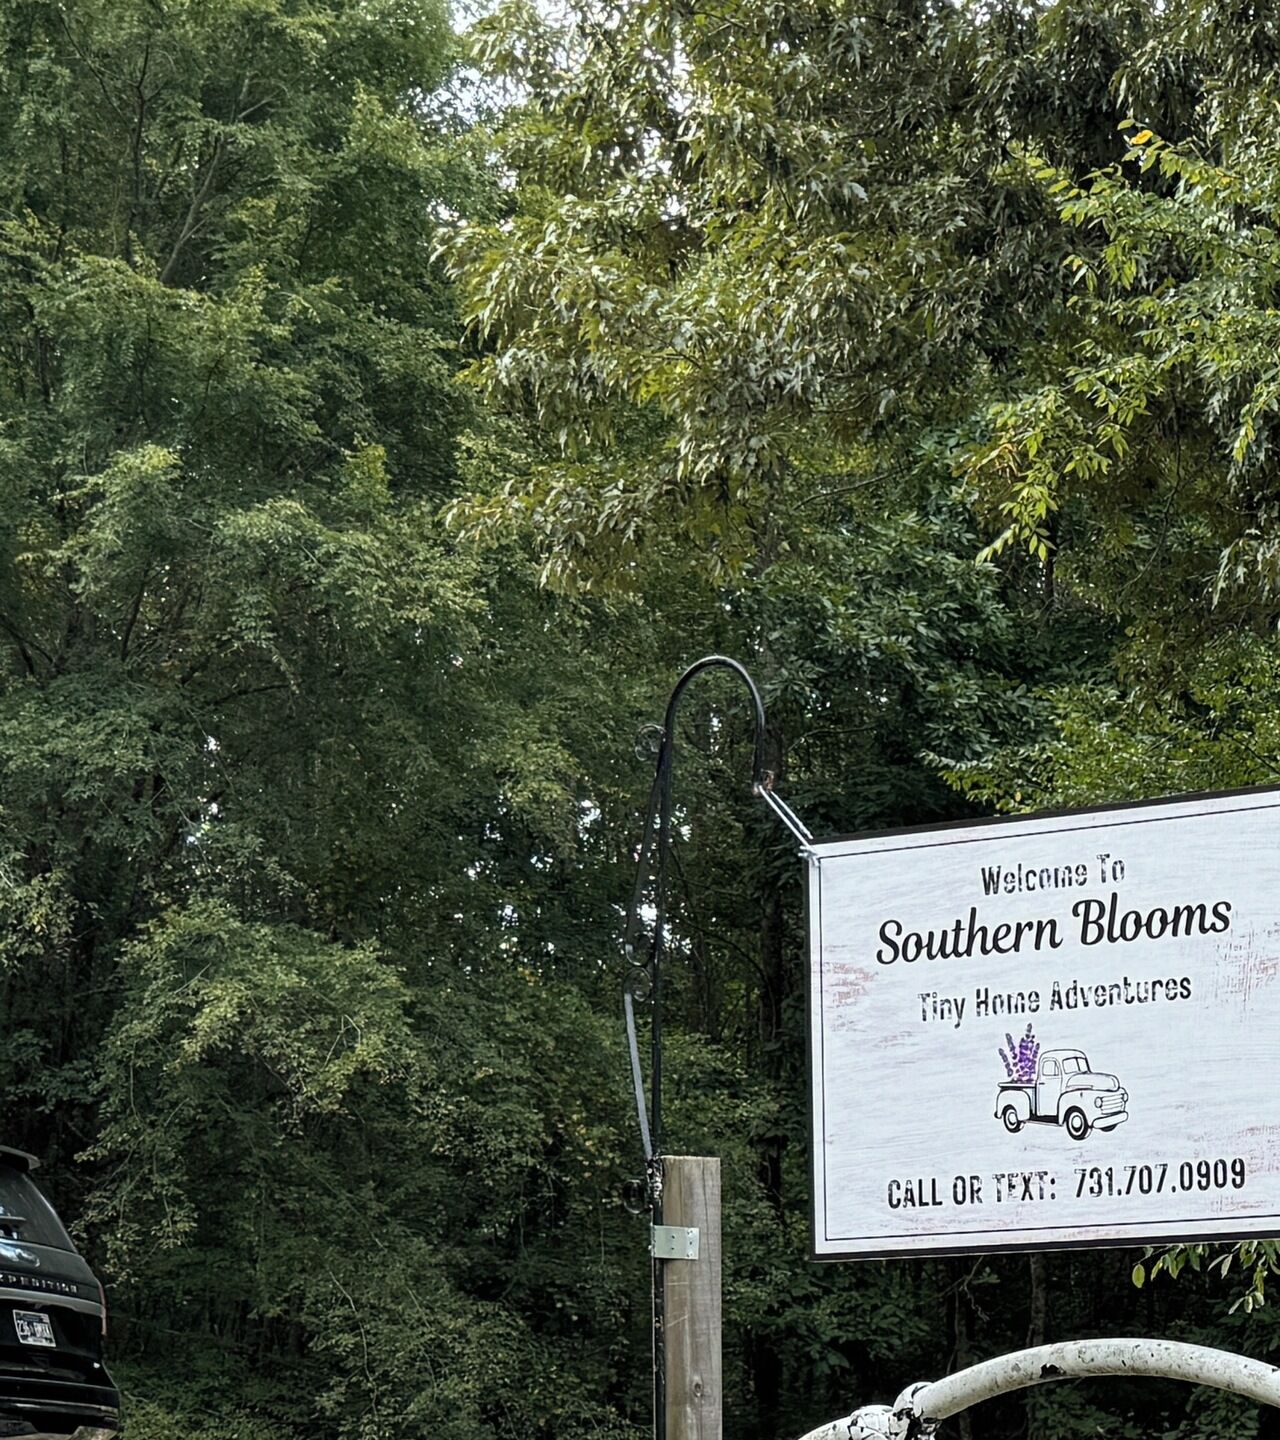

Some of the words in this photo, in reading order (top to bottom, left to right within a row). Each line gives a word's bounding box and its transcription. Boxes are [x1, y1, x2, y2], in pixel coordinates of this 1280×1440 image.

[980, 863, 1088, 896] Welcome
[1096, 853, 1126, 884] To
[876, 907, 1064, 965] Southern
[1071, 892, 1233, 946] Blooms
[918, 991, 966, 1029] Tiny
[975, 986, 1041, 1017] Home
[1049, 976, 1192, 1011] Adventures
[886, 1178, 943, 1209] CALL
[952, 1175, 983, 1206] OR
[991, 1170, 1057, 1203] TEXT:
[1073, 1158, 1246, 1199] 731.707.0909
